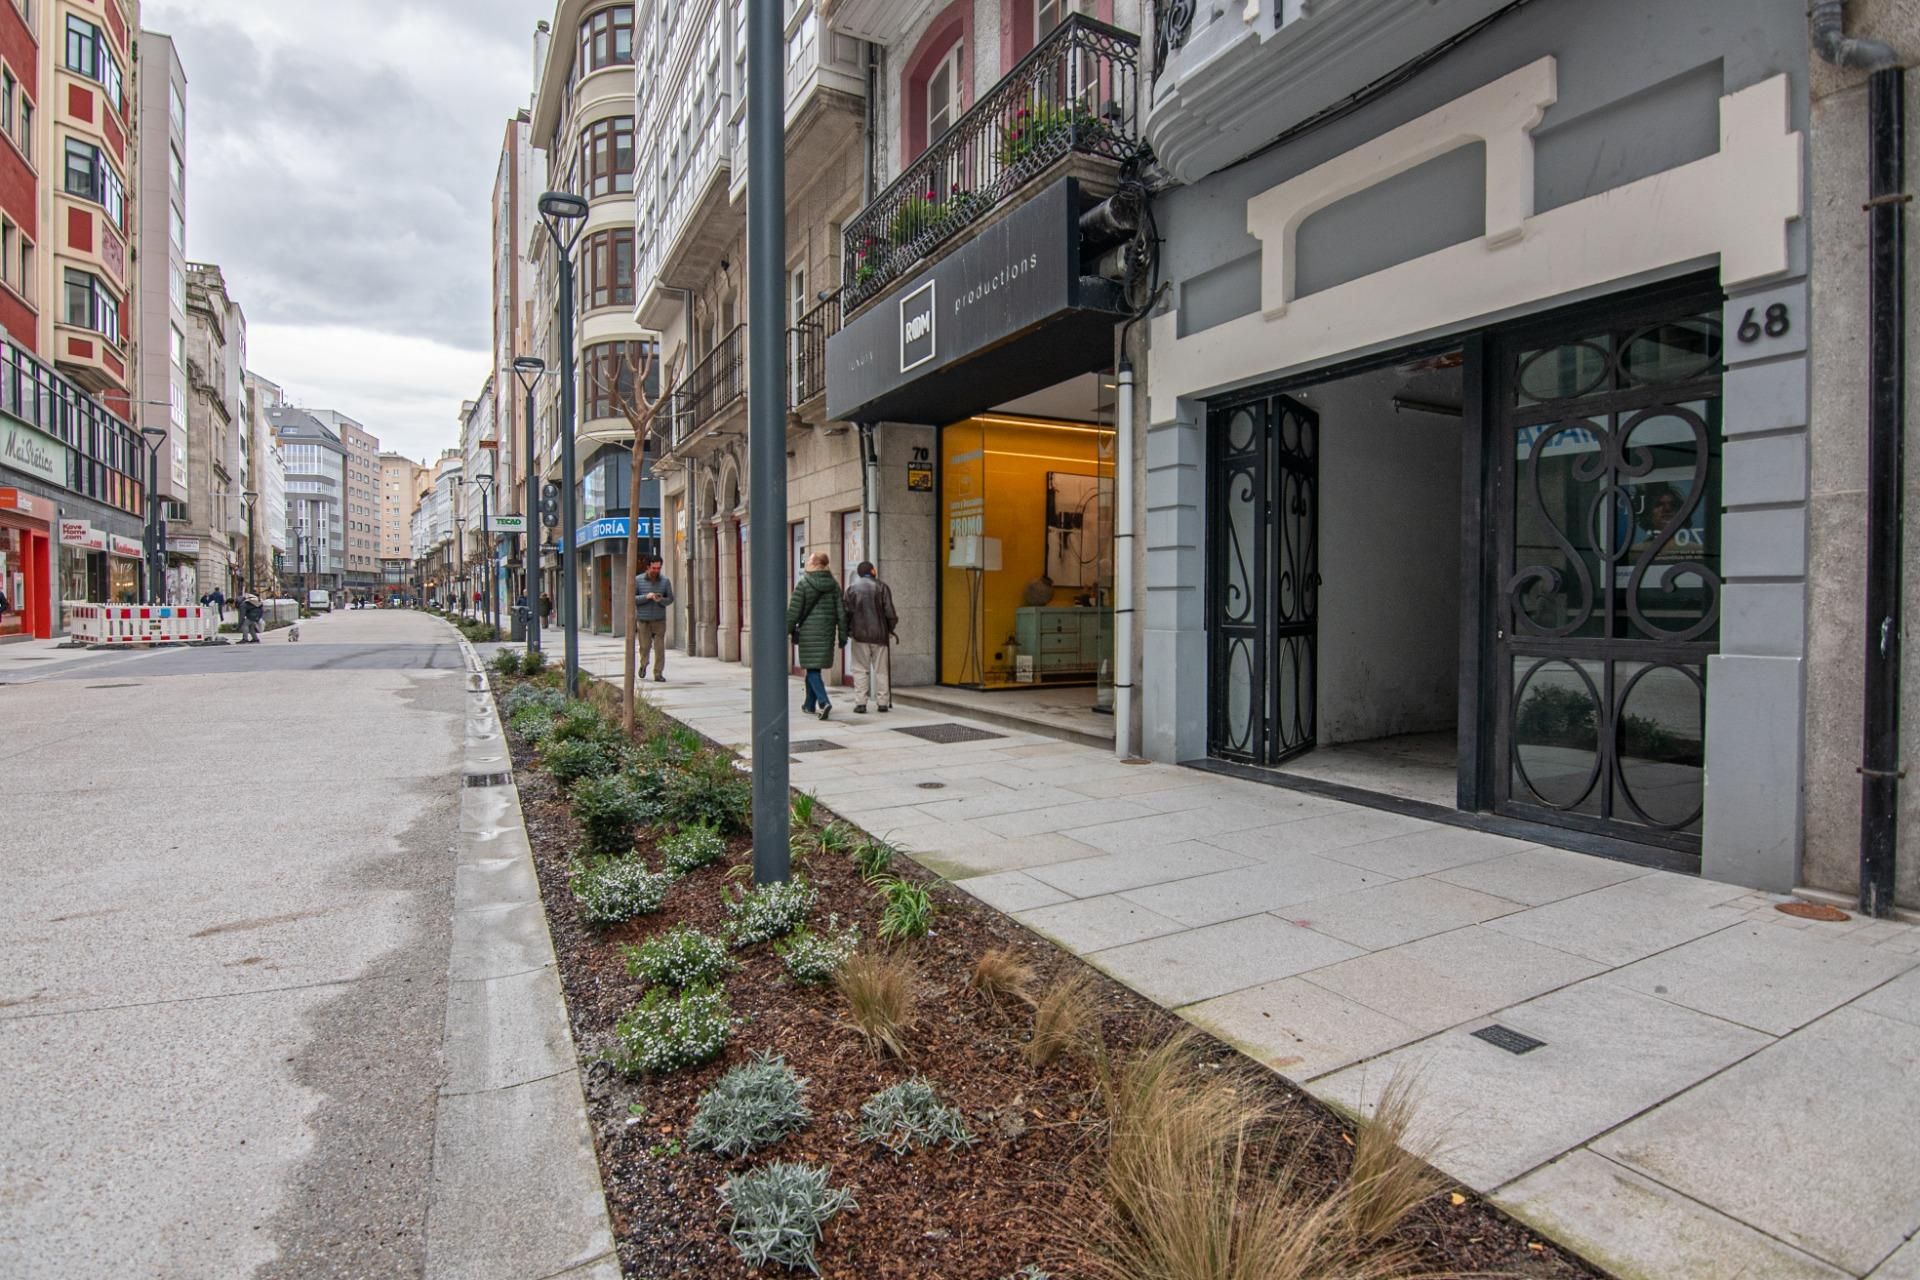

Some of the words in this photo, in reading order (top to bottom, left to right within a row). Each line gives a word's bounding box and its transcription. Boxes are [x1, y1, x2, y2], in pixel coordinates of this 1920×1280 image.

[954, 253, 1037, 316] productions
[1737, 302, 1790, 343] 68
[912, 447, 929, 461] 70
[496, 518, 522, 526] TECAD
[949, 514, 983, 537] PROMO
